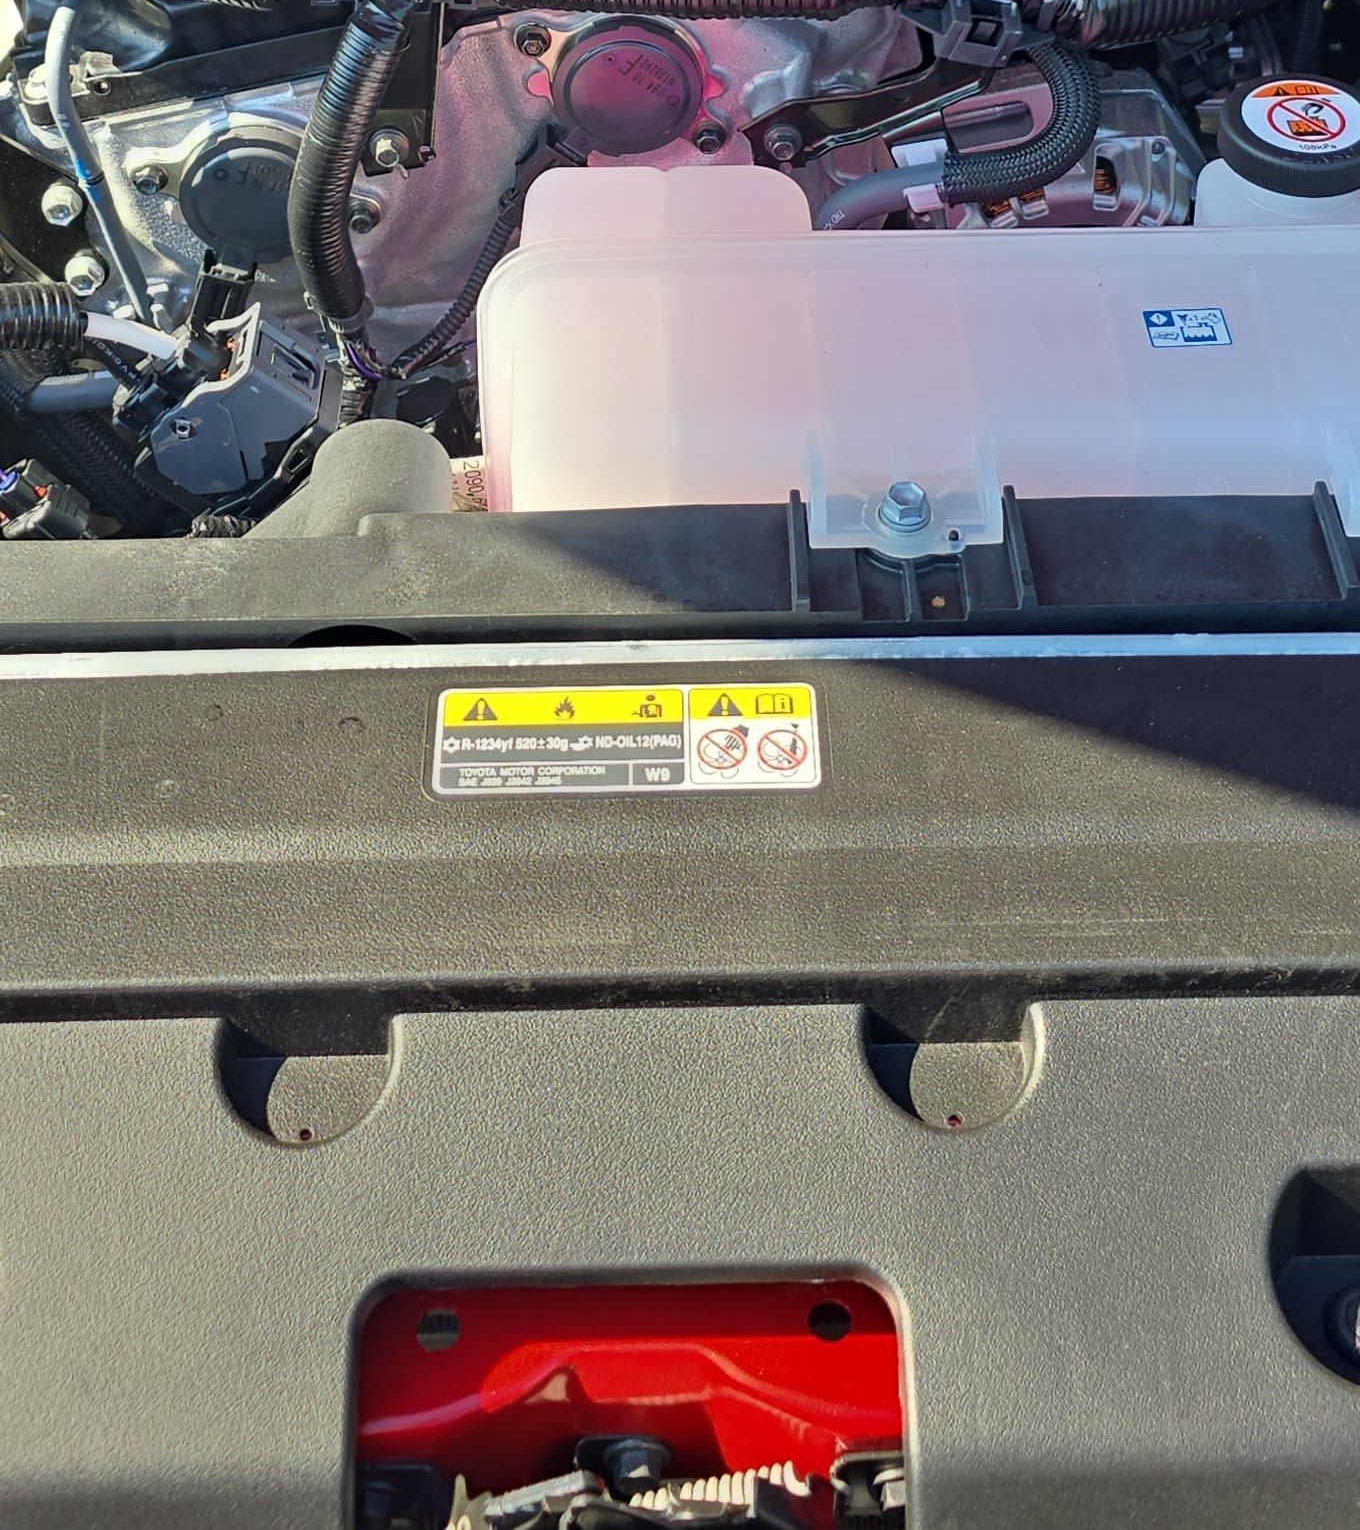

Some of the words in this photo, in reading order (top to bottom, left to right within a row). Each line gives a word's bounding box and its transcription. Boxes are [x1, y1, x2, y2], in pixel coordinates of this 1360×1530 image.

[461, 736, 514, 753] R-1234yf
[515, 736, 569, 752] 520±30g
[595, 733, 681, 749] ND-OIL12(PAG)
[458, 767, 497, 777] TOYOTA
[499, 766, 535, 776] MOTOR
[536, 765, 606, 776] CORPORATION
[644, 767, 671, 782] W9
